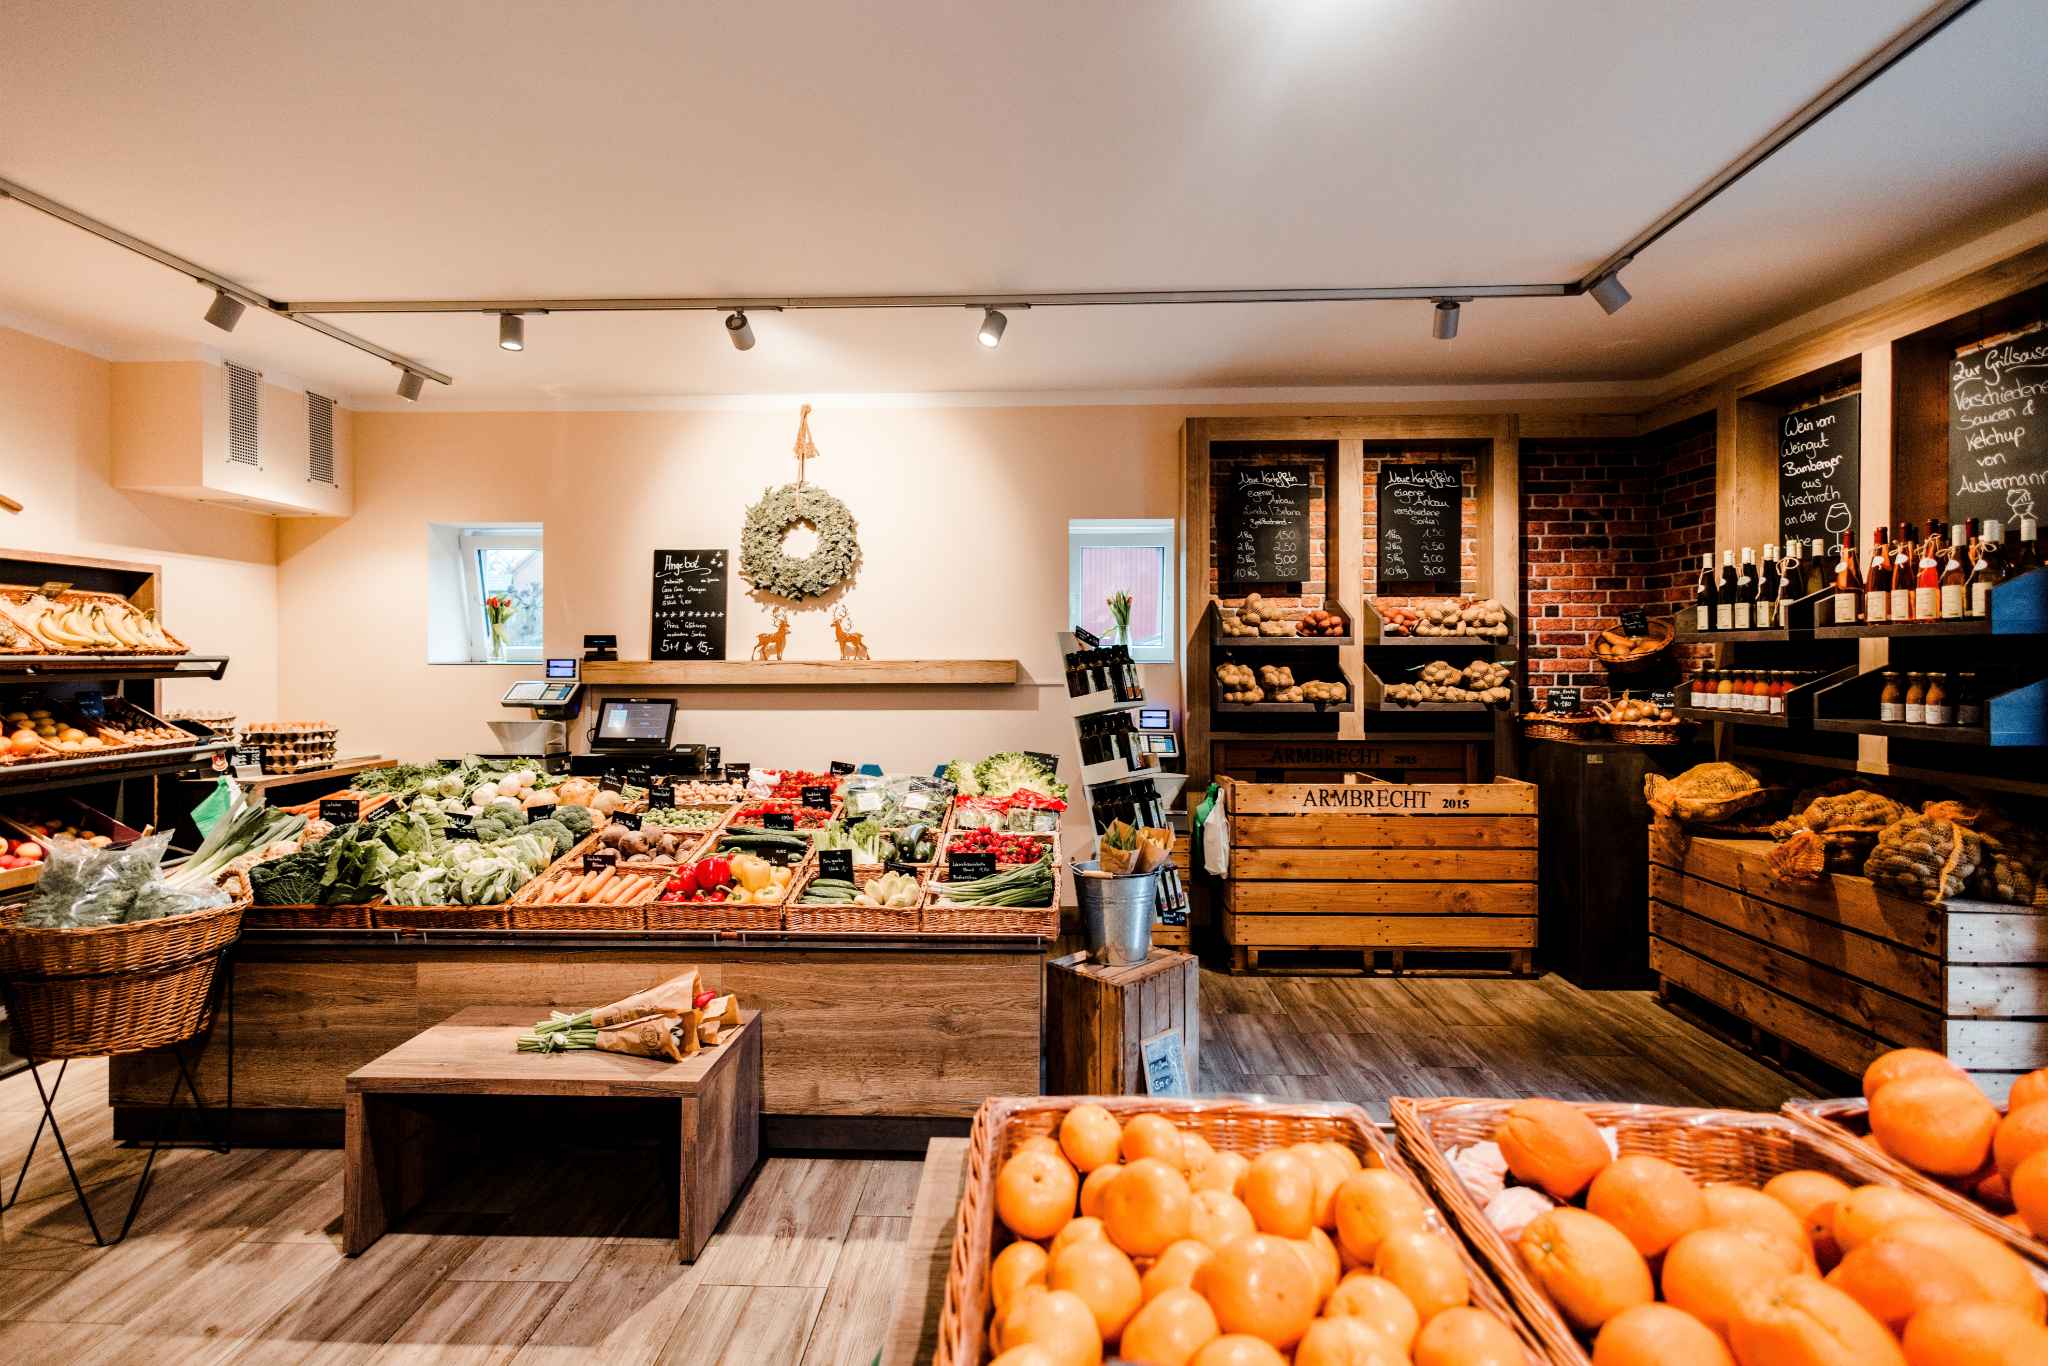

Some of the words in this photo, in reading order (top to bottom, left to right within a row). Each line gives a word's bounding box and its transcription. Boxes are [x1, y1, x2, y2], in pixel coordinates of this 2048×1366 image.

[1952, 361, 1981, 381] Zur
[1785, 416, 1814, 437] Wein
[1815, 415, 1836, 428] vom
[1781, 431, 1830, 460] Weingut
[1964, 426, 2026, 452] Ketchup
[1782, 455, 1843, 479] Bamberger
[1976, 453, 2007, 467] von
[1801, 478, 1822, 489] aus
[1784, 516, 1799, 527] an
[1799, 509, 1818, 524] der
[664, 554, 701, 576] Angebot
[1272, 747, 1385, 764] ARMBRECHT
[1303, 788, 1432, 809] ARMBRECHT
[1442, 798, 1470, 810] 2015
